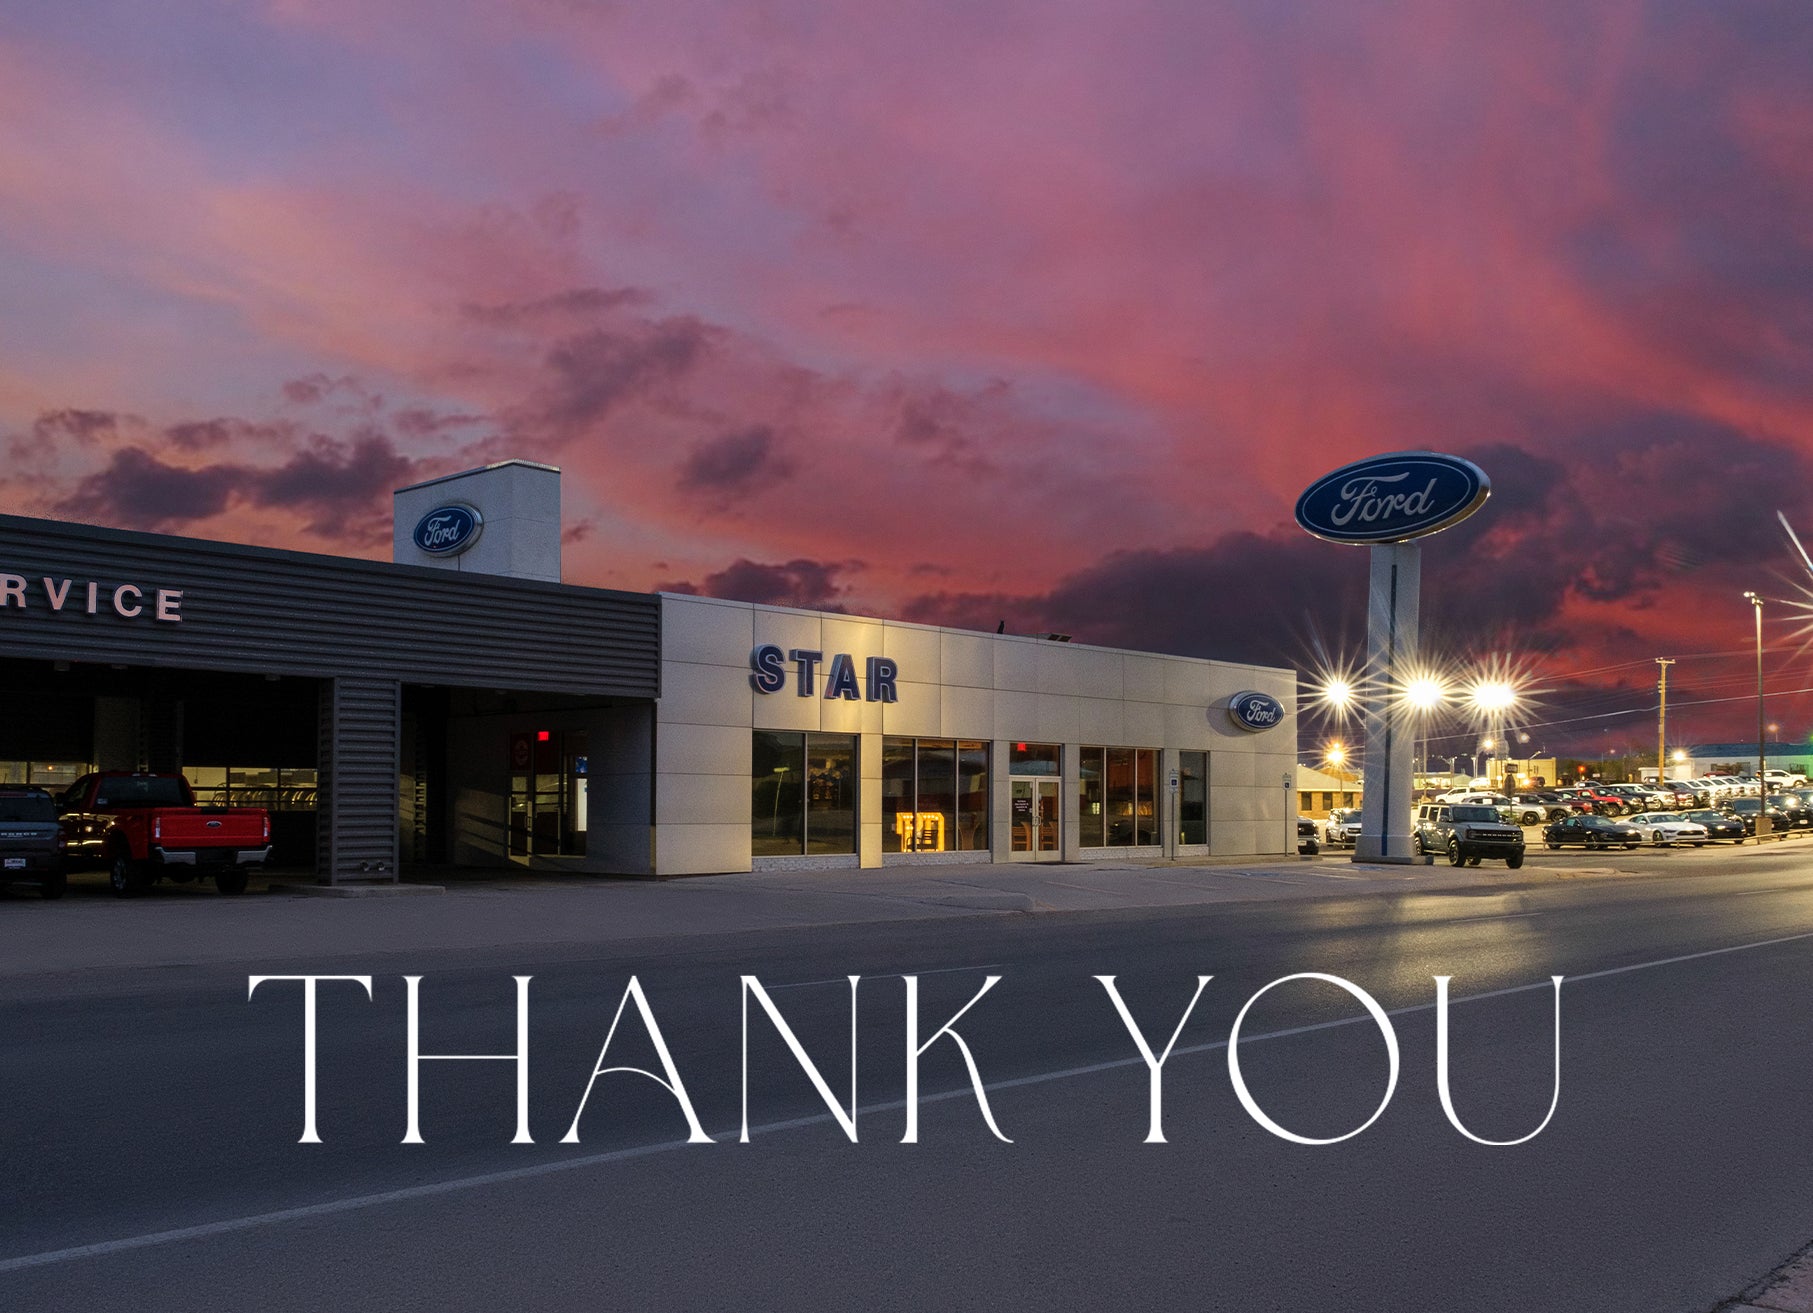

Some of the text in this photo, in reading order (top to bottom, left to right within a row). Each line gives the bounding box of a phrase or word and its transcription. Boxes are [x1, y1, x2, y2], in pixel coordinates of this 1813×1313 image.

[1330, 471, 1438, 526] Ford
[424, 515, 460, 546] Ford
[0, 573, 183, 622] RVICE
[752, 644, 899, 703] STAR
[1246, 700, 1276, 722] Ford
